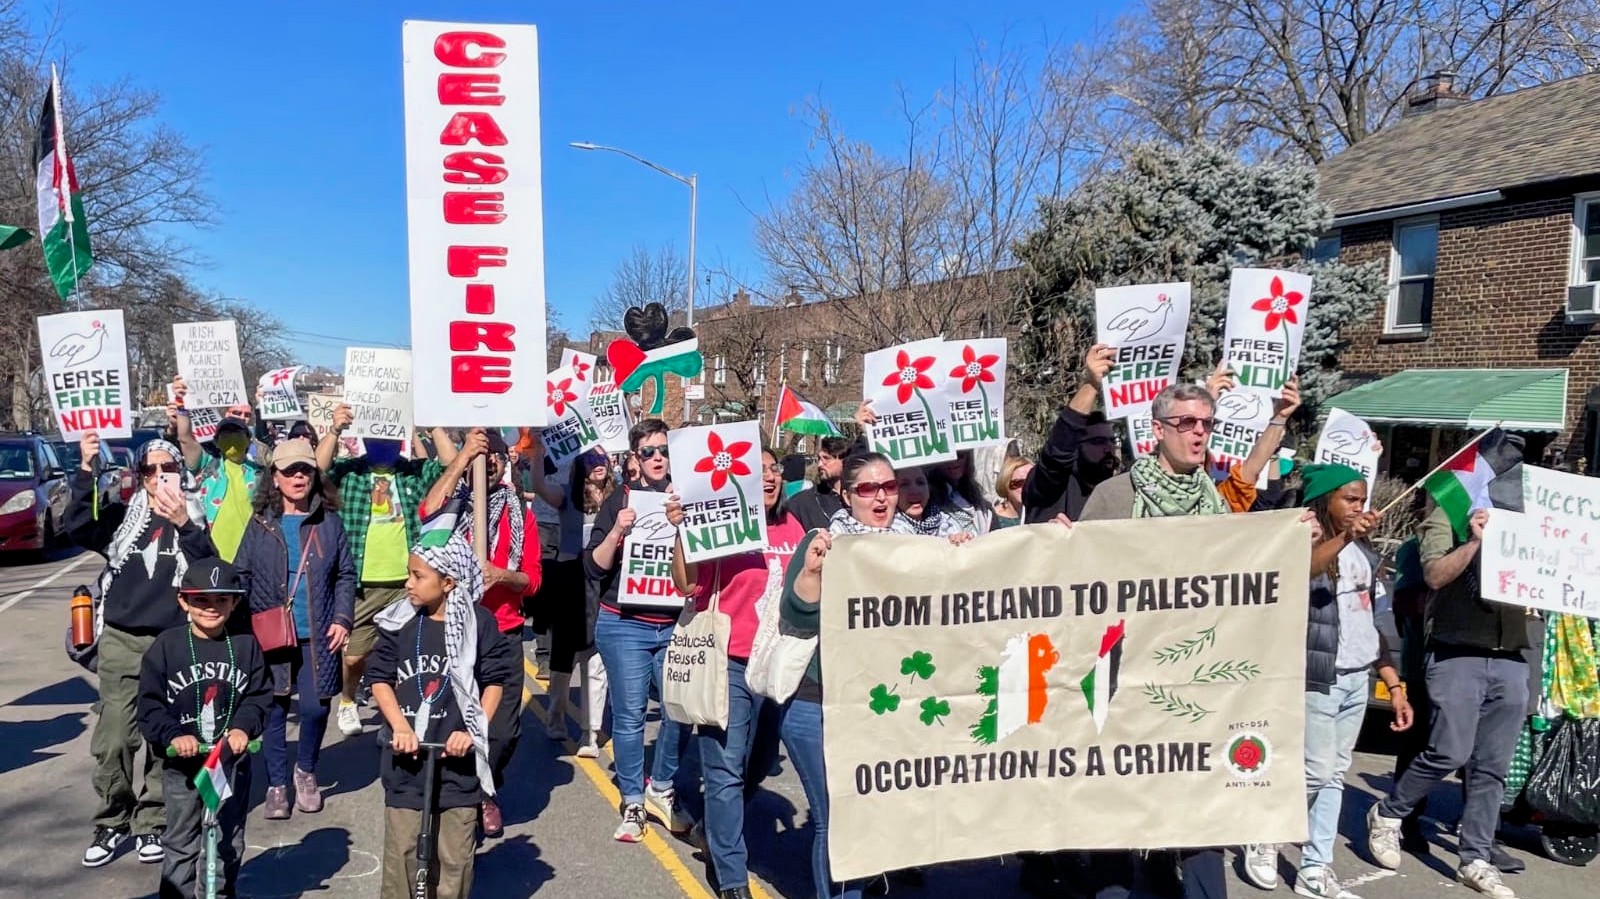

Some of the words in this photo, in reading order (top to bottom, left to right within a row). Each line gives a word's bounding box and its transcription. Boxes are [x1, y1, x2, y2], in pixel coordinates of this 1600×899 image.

[434, 31, 508, 224] CEASE
[447, 245, 516, 394] FIRE
[189, 326, 214, 338] IRISH
[180, 340, 230, 352] AMERICANS
[1118, 344, 1176, 363] EASE
[1230, 338, 1284, 353] FREE
[188, 354, 222, 366] AGAINST
[350, 350, 376, 364] IRISH
[52, 370, 120, 391] CEASE
[193, 368, 224, 378] FORCED
[348, 364, 400, 380] AMERICANS
[188, 380, 240, 394] STARVATION
[374, 380, 410, 394] AGAINST
[208, 392, 240, 405] GAZA
[346, 390, 380, 404] FORCED
[264, 400, 298, 414] NOW
[354, 404, 402, 422] TARVATION
[592, 404, 620, 418] CEAS
[60, 408, 122, 432] NOW
[542, 416, 578, 438] FREE
[872, 410, 926, 427] FREE
[370, 424, 406, 438] GAZA
[550, 426, 599, 461] NOW
[875, 432, 950, 460] NOW
[681, 496, 738, 513] FREE
[686, 518, 762, 552] NOW
[1540, 516, 1570, 538] for
[847, 595, 932, 630] FROM
[940, 585, 1062, 626] IRELAND
[1070, 581, 1109, 617] TO
[1117, 571, 1280, 613] PALESTINE
[166, 662, 248, 704] ALESTIN
[666, 668, 690, 682] Read
[856, 750, 1038, 795] OCCUPATION
[1048, 748, 1076, 778] IS
[1086, 746, 1102, 776] A
[1114, 742, 1212, 774] CRIME
